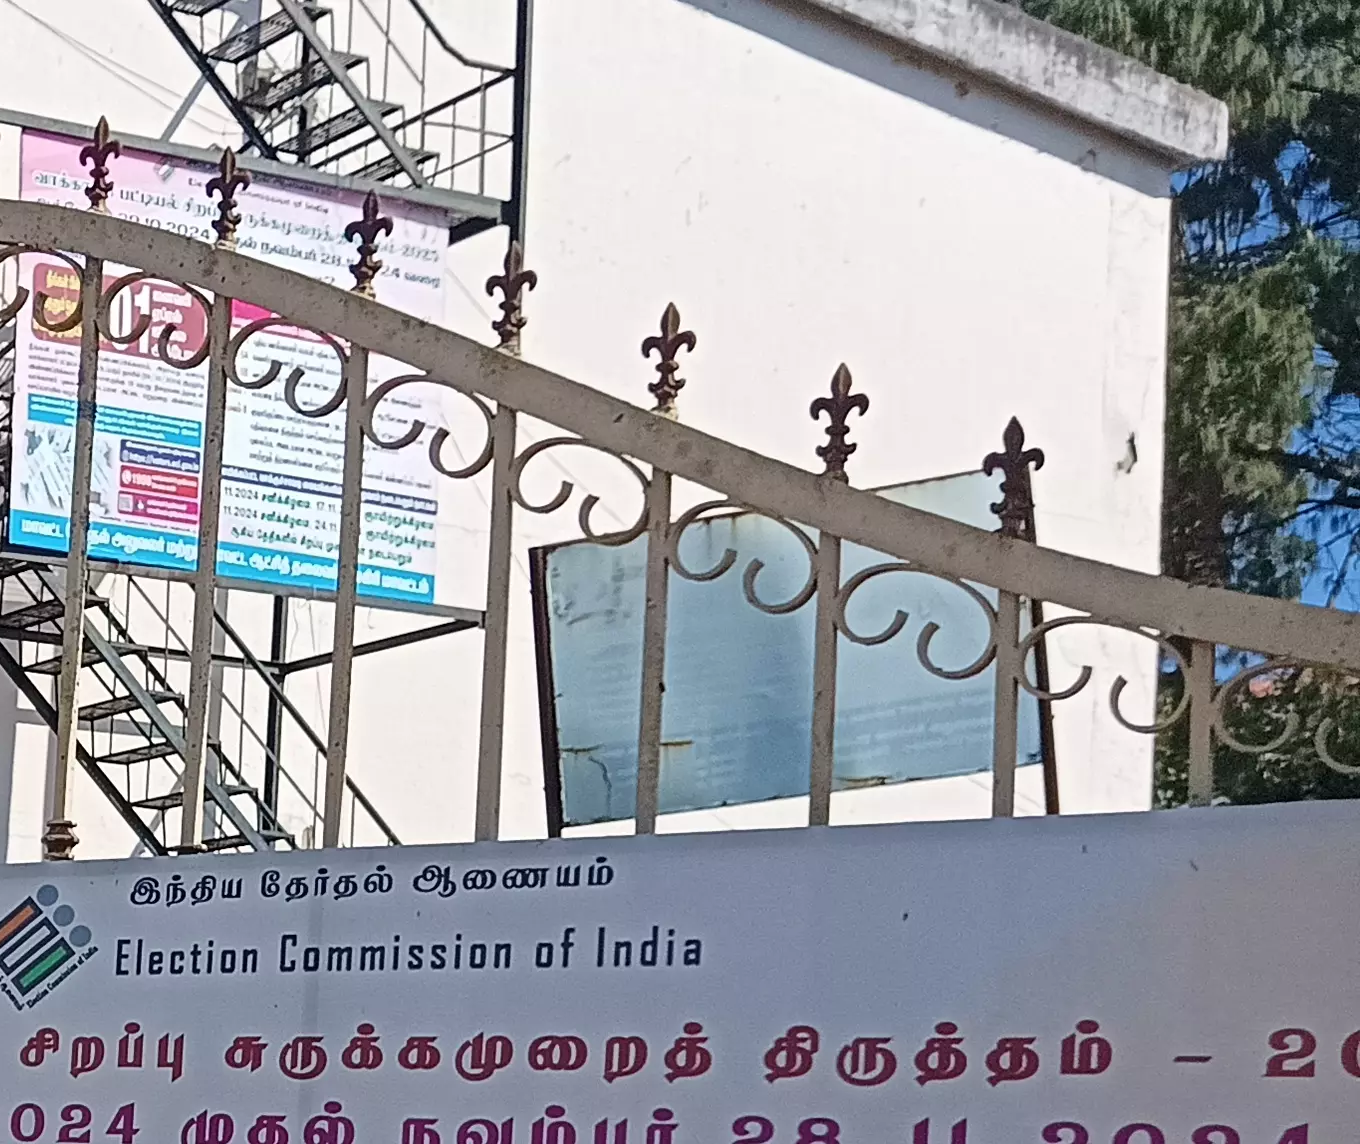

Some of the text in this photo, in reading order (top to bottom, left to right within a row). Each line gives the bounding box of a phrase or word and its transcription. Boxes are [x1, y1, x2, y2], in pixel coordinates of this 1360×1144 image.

[130, 856, 614, 907] இந்திய தேர்தல் ஆணையம்
[116, 926, 701, 975] Election Commission of India
[20, 1022, 184, 1082] சிறப்பு
[225, 1022, 711, 1083] சுருக்கமுறைத்
[764, 1020, 1112, 1087] திருத்தம்
